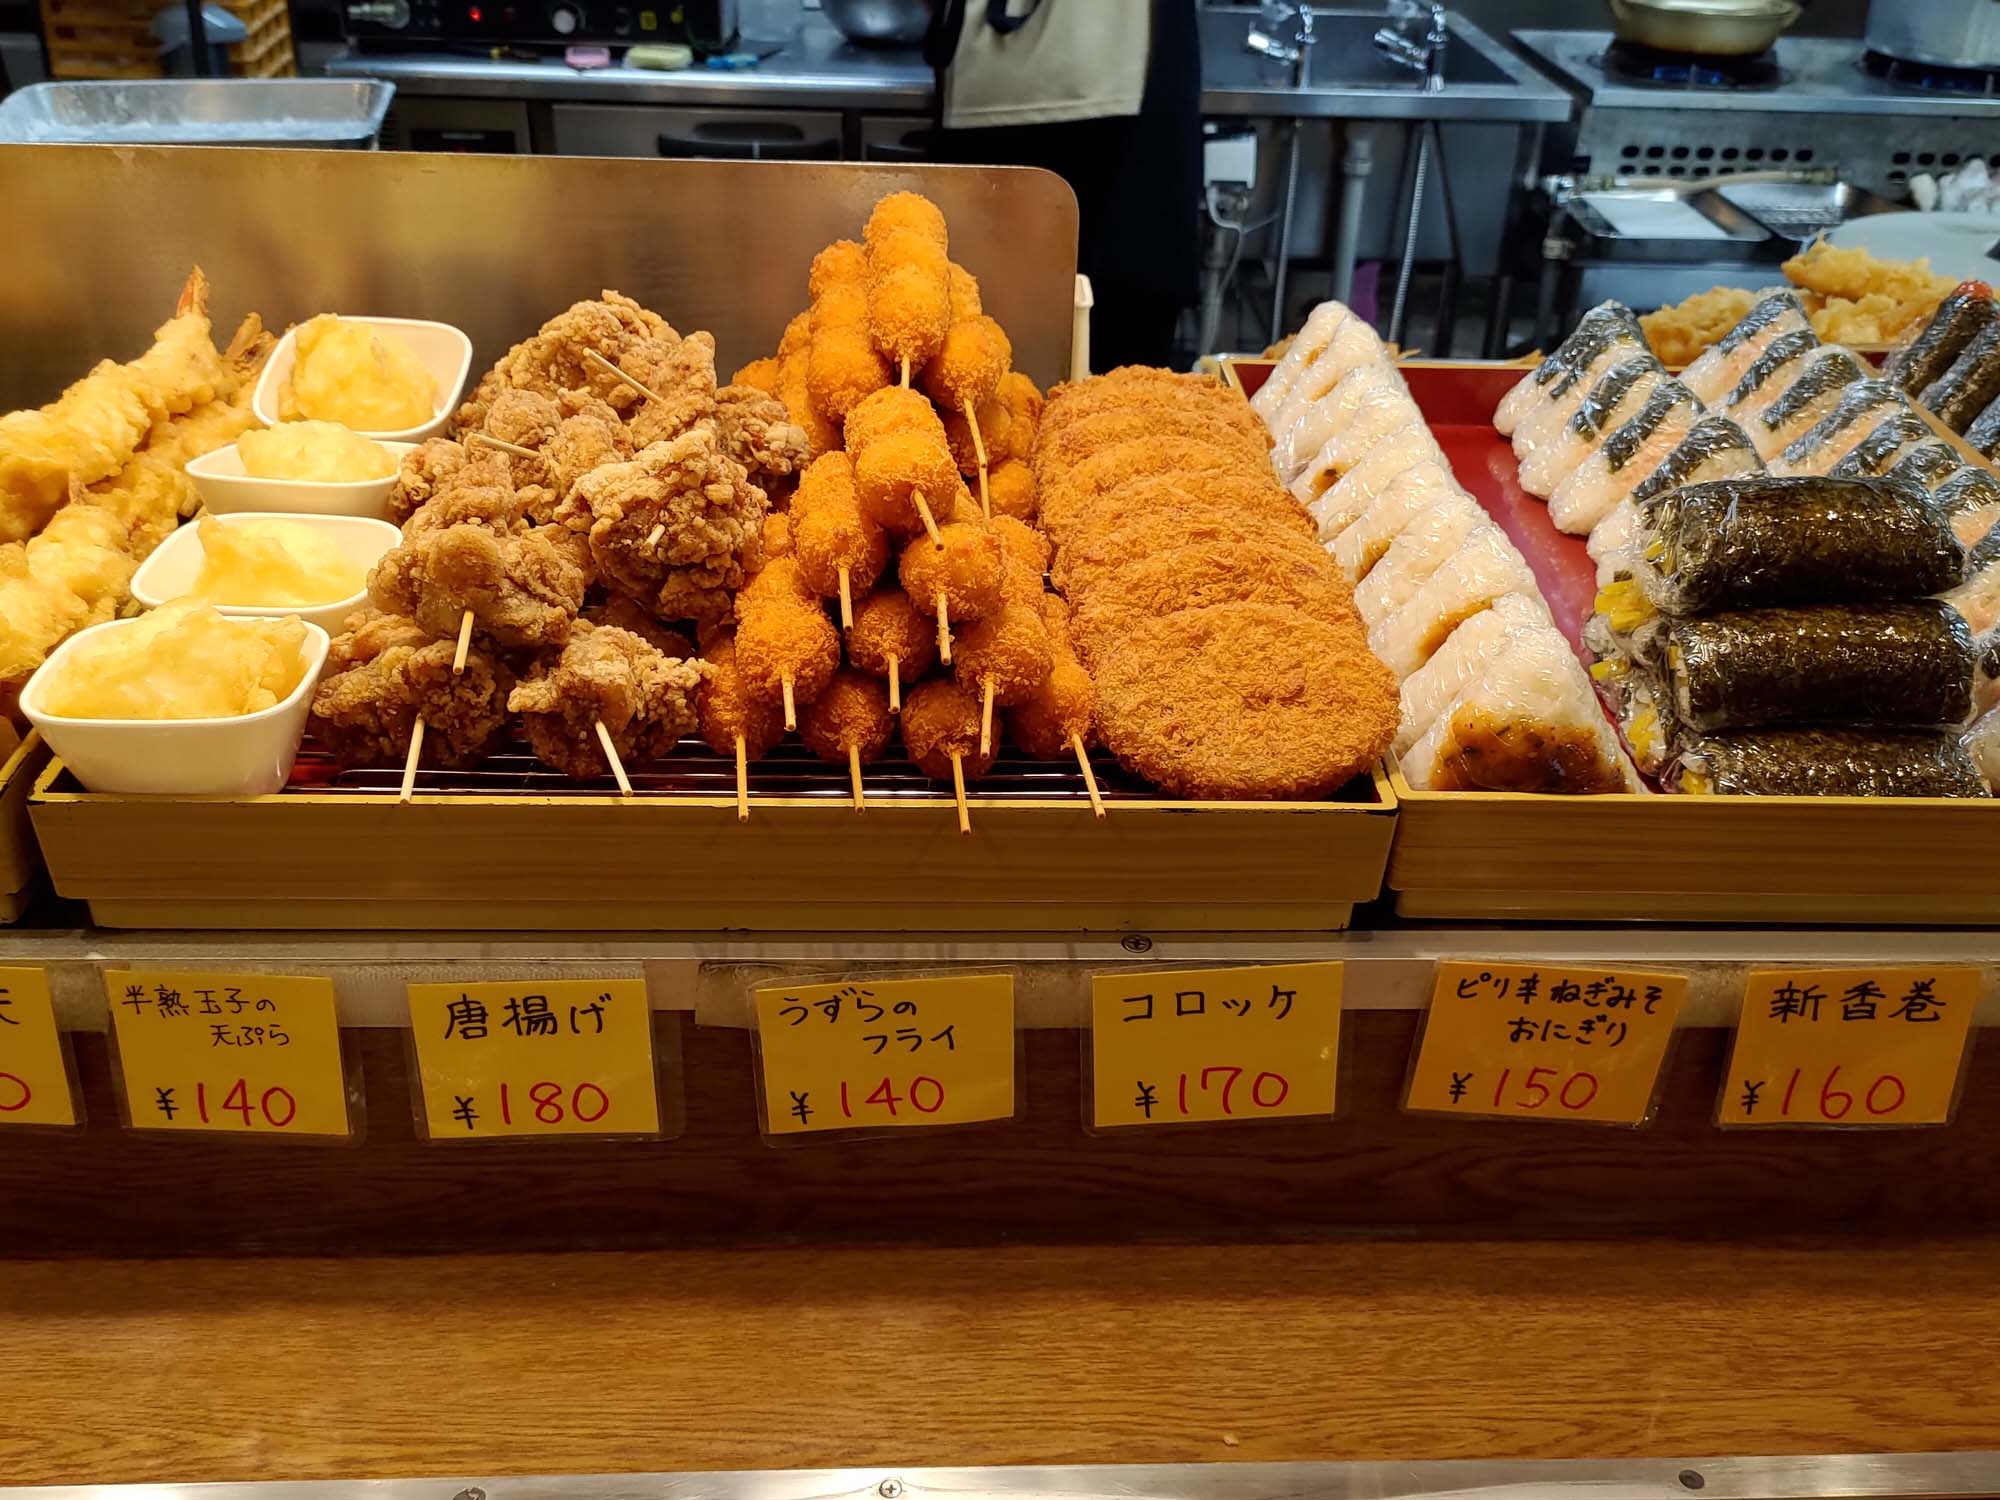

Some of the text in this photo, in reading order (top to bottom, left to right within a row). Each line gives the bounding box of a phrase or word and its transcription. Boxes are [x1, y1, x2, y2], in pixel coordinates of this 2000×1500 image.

[121, 984, 277, 1018] 半熟玉子の
[444, 991, 612, 1041] 唐揚げ
[778, 986, 917, 1030] うずらの
[1122, 984, 1297, 1023] コロッケ
[1767, 977, 1947, 1024] 新香巻
[209, 1023, 291, 1048] 天ぷら
[862, 1024, 955, 1055] フライ
[1507, 1014, 1628, 1048] おにぎり
